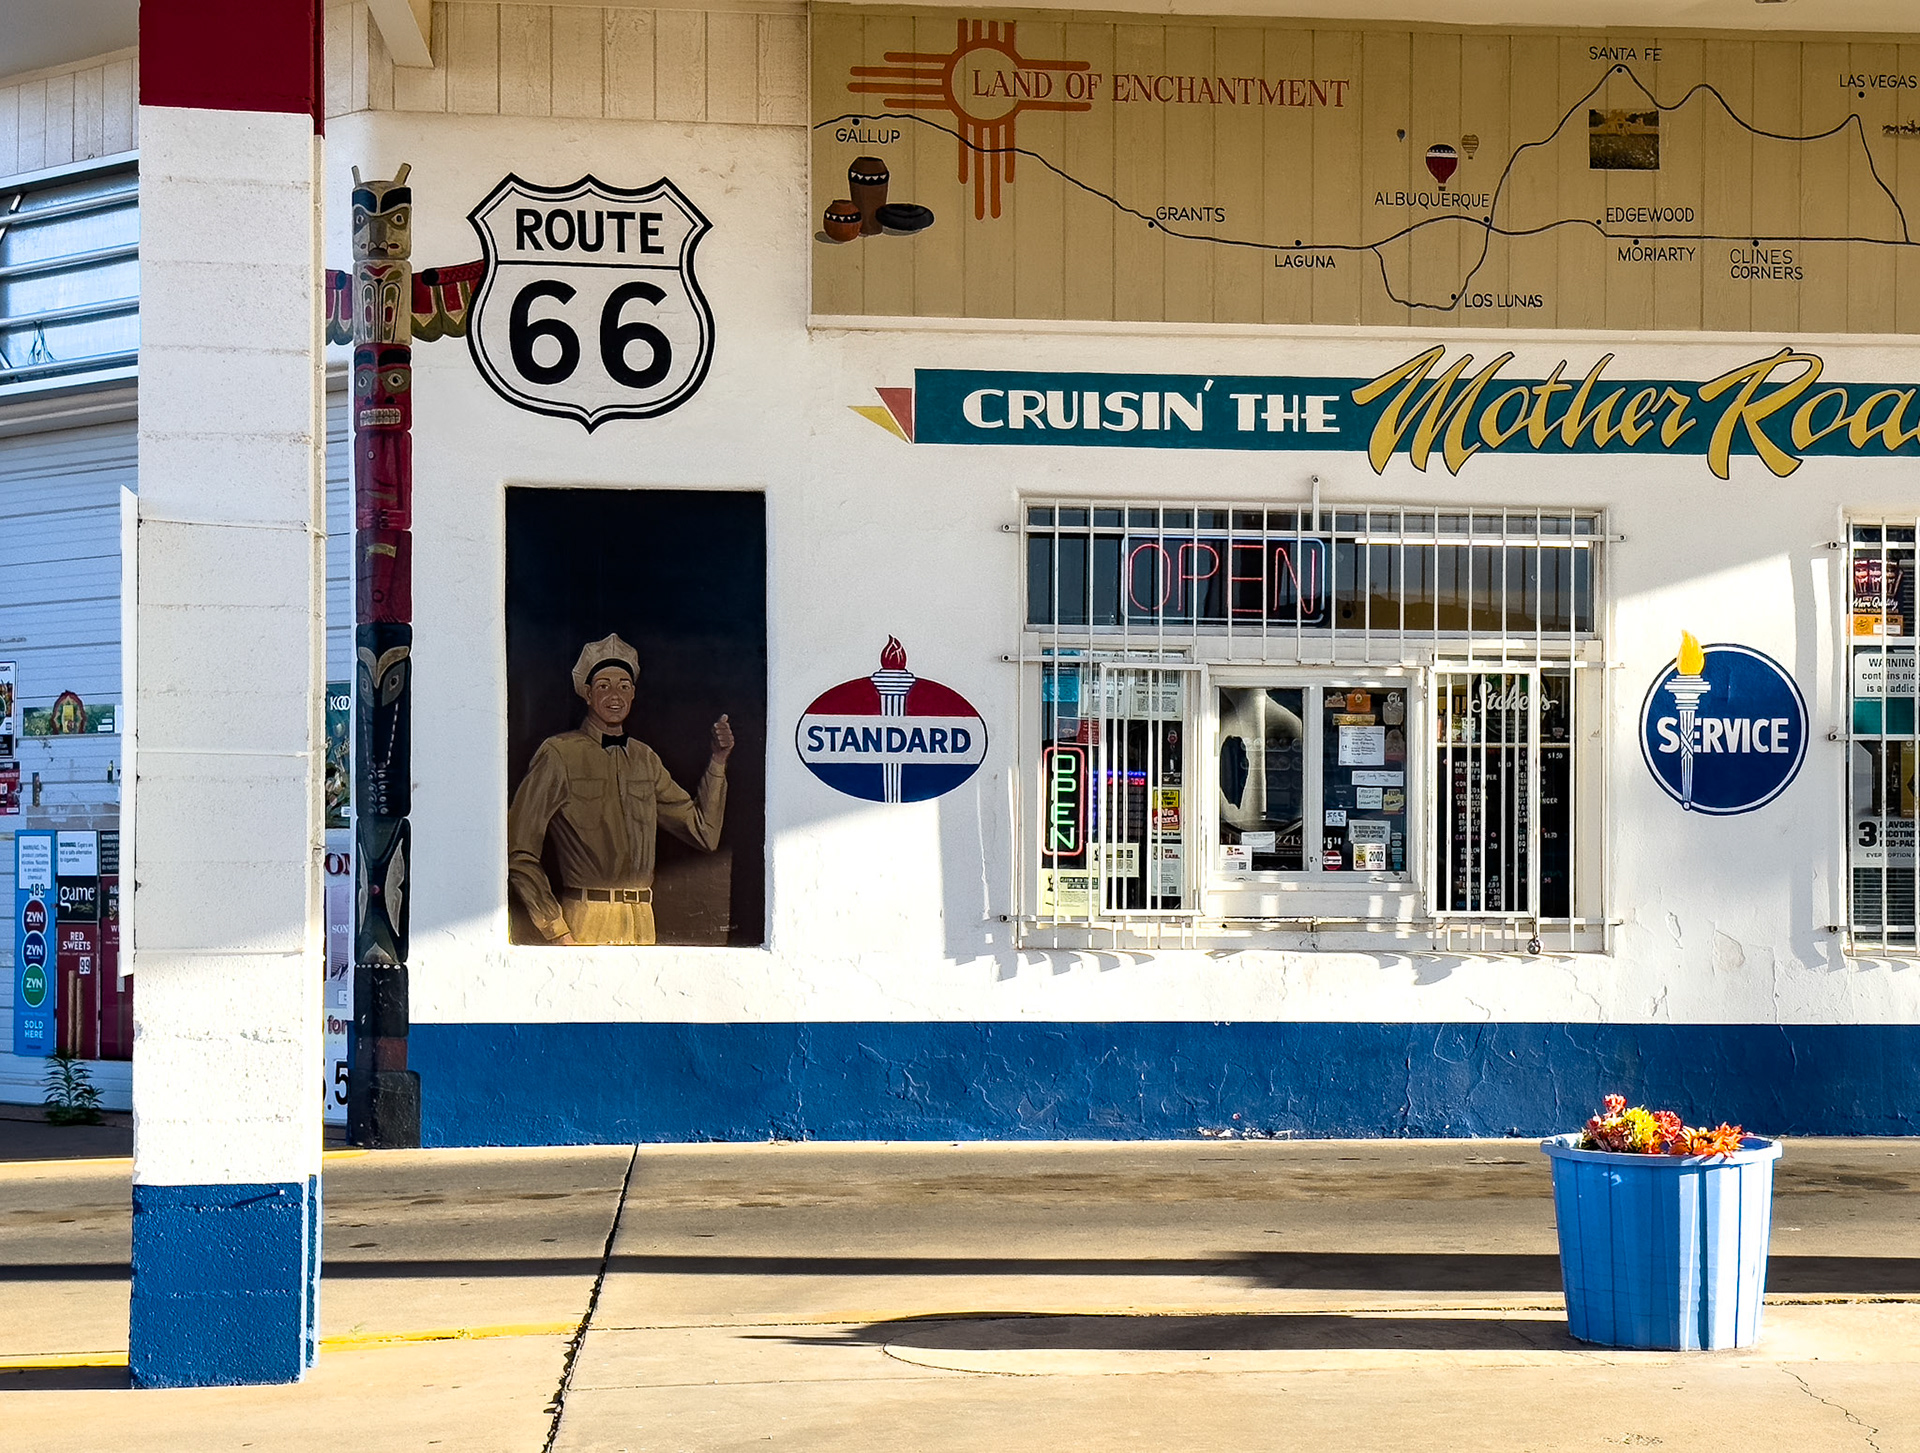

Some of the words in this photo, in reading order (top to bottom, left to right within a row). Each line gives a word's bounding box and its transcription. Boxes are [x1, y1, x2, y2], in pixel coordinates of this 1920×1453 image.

[1589, 47, 1637, 61] SANTA
[1644, 47, 1662, 61] FE
[971, 68, 1053, 99] LAND
[1064, 72, 1102, 100] OF
[1112, 74, 1350, 108] ENCHANTMENT
[1839, 74, 1866, 88] LAS
[1869, 75, 1918, 89] VEGAS
[835, 128, 900, 144] GALLUP
[1374, 191, 1490, 210] ALBUQUERQUE
[1156, 206, 1226, 223] GRANTS
[1605, 207, 1695, 223] EDGEWOOD
[516, 208, 665, 255] ROUTE
[1274, 255, 1336, 269] LAGUNA
[1617, 247, 1696, 262] MORIARTY
[1729, 248, 1793, 265] CLINES
[1730, 265, 1804, 280] CORNERS
[1464, 293, 1493, 308] LOS
[1497, 294, 1543, 308] LUNAS
[509, 279, 672, 389] 66
[1229, 392, 1341, 432] THE
[1351, 343, 1697, 478] Mother
[1128, 542, 1316, 615] OPEN
[1871, 596, 1899, 611] Qulity
[1861, 671, 1900, 680] contins
[1866, 684, 1874, 693] is
[1876, 685, 1888, 693] a
[807, 725, 971, 754] STANDARD
[1656, 716, 1789, 754] SERVICE
[1049, 754, 1076, 850] OPEN
[1858, 821, 1877, 848] 3
[60, 885, 95, 914] game
[26, 911, 44, 923] ZYN
[70, 931, 84, 941] RED
[26, 944, 43, 956] ZYN
[62, 941, 92, 950] SWEETS
[80, 958, 91, 973] 99
[26, 978, 43, 988] ZYN
[24, 1020, 43, 1029] SOLD
[327, 1014, 348, 1035] for
[24, 1030, 43, 1039] HERE
